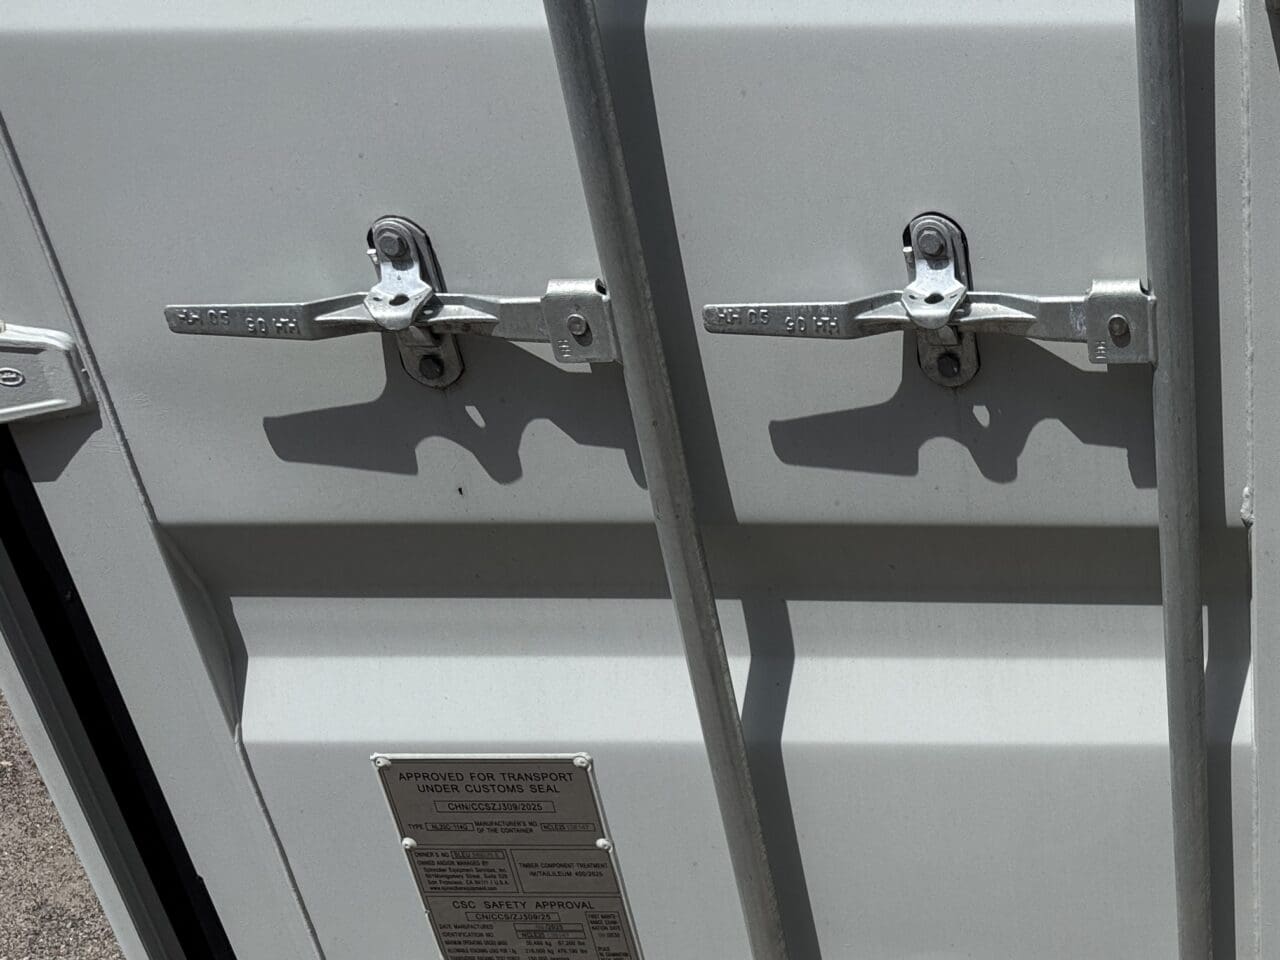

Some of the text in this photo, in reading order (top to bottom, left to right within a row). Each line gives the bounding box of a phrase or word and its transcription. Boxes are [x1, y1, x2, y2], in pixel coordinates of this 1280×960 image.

[398, 772, 575, 782] APPROVED FOR TRANSPORT
[417, 784, 561, 794] UNDER CUSTOMS SEAL
[452, 900, 596, 910] CSC SAFETY APPROVAL
